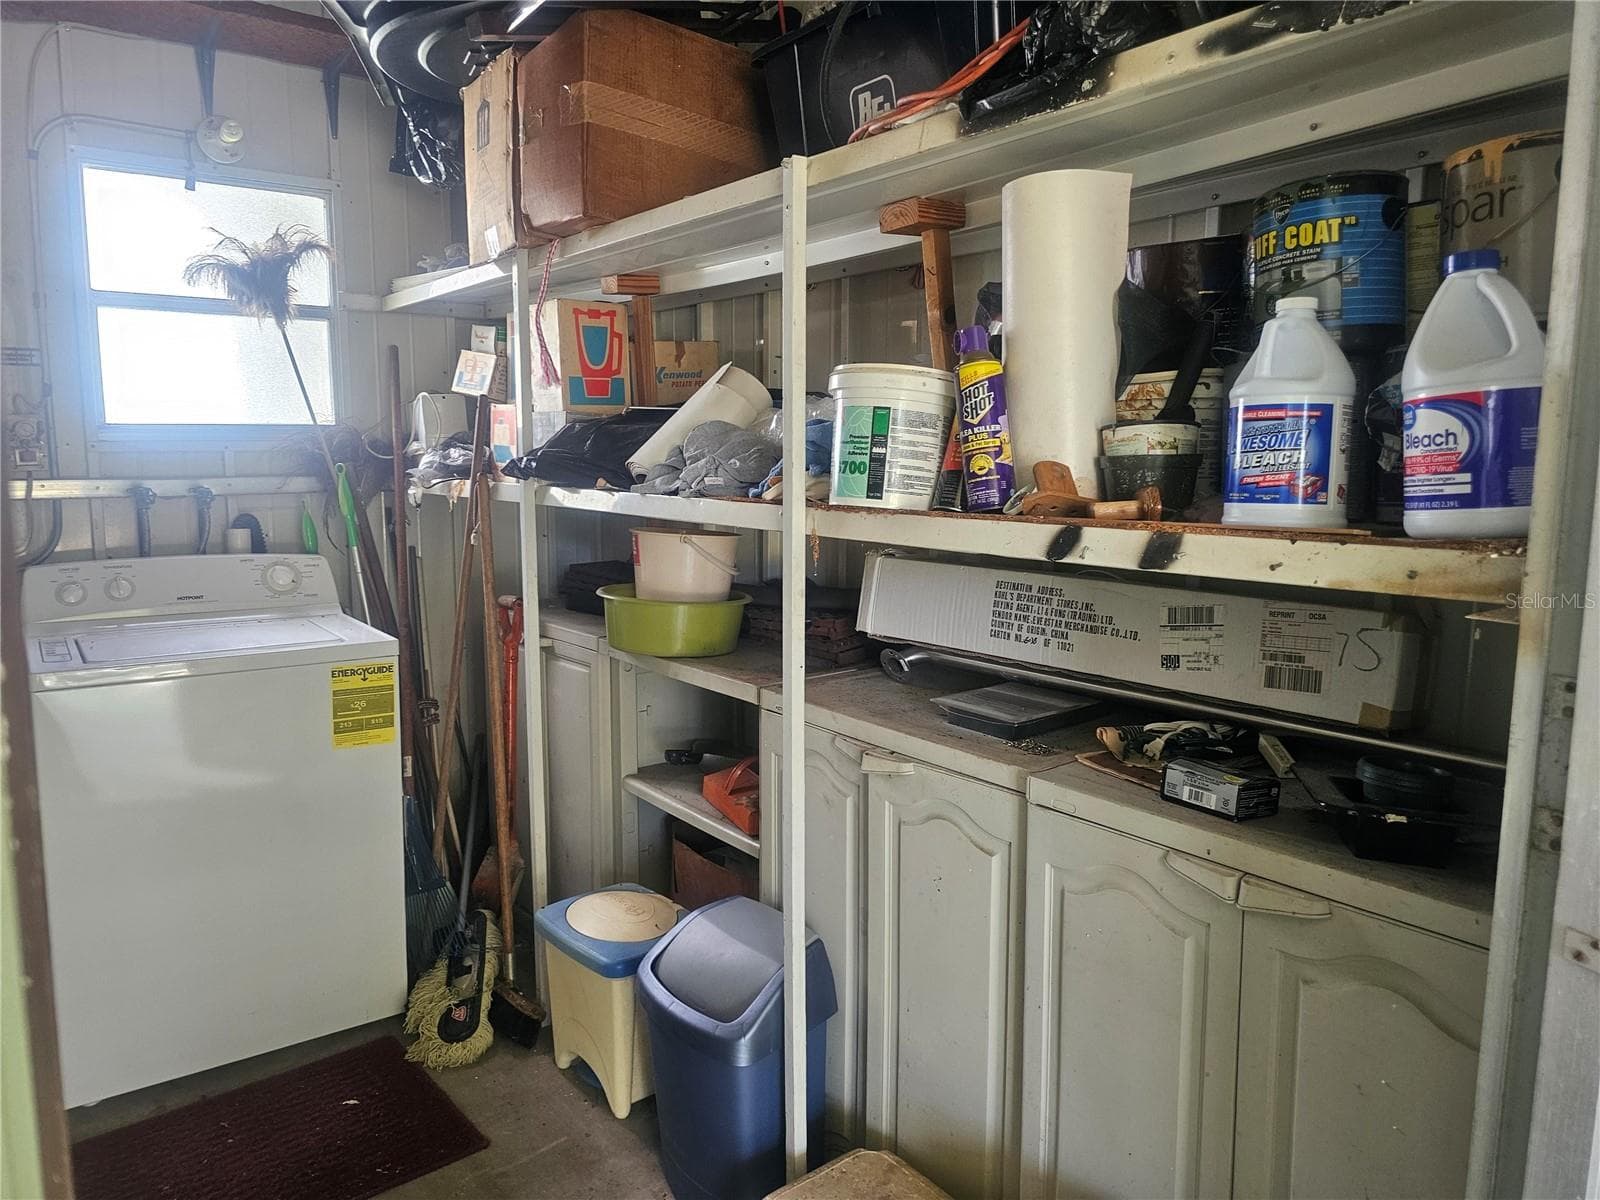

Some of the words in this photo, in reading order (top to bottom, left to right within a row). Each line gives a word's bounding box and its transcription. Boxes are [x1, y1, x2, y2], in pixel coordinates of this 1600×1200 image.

[1284, 218, 1342, 250] COAT
[1272, 250, 1301, 262] CONCRETE
[656, 367, 704, 384] Kenwood
[963, 382, 988, 404] HOT
[963, 394, 993, 420] SHOT
[968, 433, 989, 442] PLUS
[974, 424, 1002, 433] KILLER
[1232, 429, 1310, 454] WESOME
[1405, 429, 1457, 450] Bleach
[1265, 473, 1291, 481] SCENT
[995, 580, 1033, 593] DESTINATION
[994, 590, 1014, 601] KOHL'S
[1015, 592, 1053, 607] DEPARTMENT
[992, 600, 1014, 611] BUYING
[1050, 607, 1066, 619] FUNG
[1067, 609, 1099, 623] (TRADING)
[1100, 614, 1116, 626] LTD.
[1268, 610, 1296, 619] REPRINT
[1308, 612, 1327, 621] OCSA
[990, 619, 1014, 631] COUNTRY
[1017, 623, 1024, 632] OF
[1050, 629, 1069, 641] CHINA
[991, 610, 1012, 621] VENDOR
[1064, 620, 1108, 636] MERCHANDISE
[989, 629, 1011, 641] CARTON
[1044, 638, 1051, 648] OF
[331, 665, 394, 680] ENERGYGUIDE
